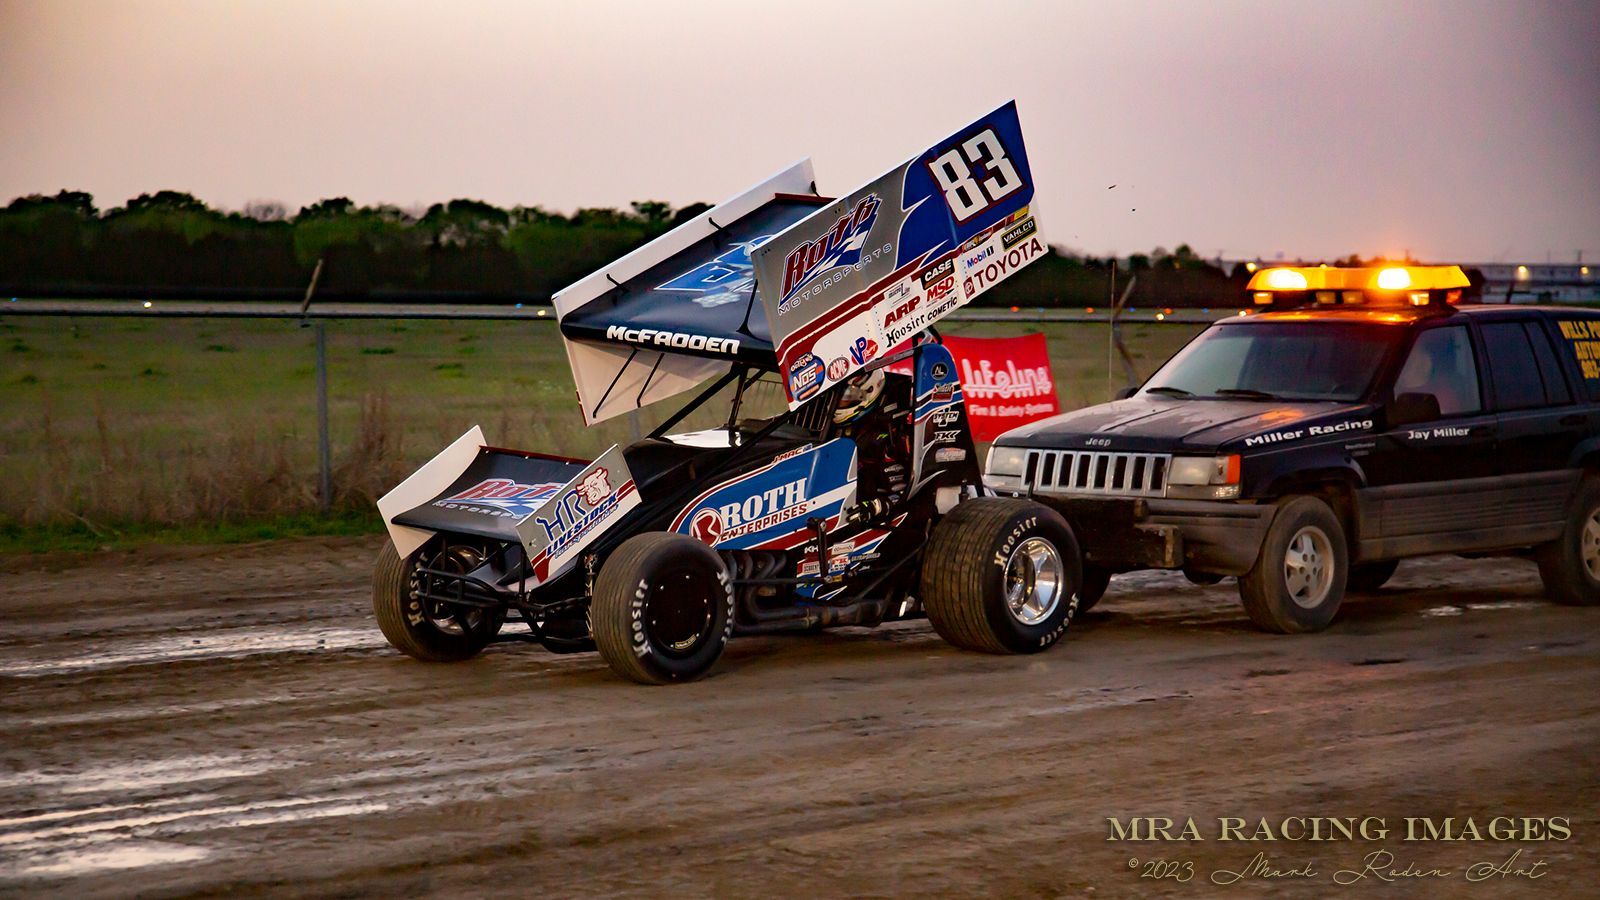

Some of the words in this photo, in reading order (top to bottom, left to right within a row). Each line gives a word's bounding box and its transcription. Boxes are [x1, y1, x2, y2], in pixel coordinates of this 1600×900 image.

[928, 129, 1023, 222] 83
[1003, 220, 1034, 243] VAHLCO
[778, 192, 883, 309] Roth
[966, 251, 987, 268] Mobil
[973, 237, 1043, 288] TOYOTA
[777, 242, 893, 316] MOTORSPORTS
[924, 260, 952, 282] CASE
[926, 276, 955, 302] MSD
[884, 295, 920, 328] ARP
[927, 296, 958, 321] COMETIC
[886, 314, 925, 348] Hoosier
[849, 336, 868, 365] VP
[793, 366, 817, 391] NOS
[829, 359, 847, 379] ACME
[1085, 437, 1111, 447] Jeep
[1245, 430, 1304, 446] Miller
[1309, 419, 1373, 436] Racing
[1408, 430, 1430, 440] Jay
[1433, 427, 1470, 438] Miller
[449, 479, 564, 500] Rot
[719, 477, 807, 529] ROTH
[547, 493, 617, 556] LIVESTOCK
[720, 504, 807, 542] ENTERPRISES
[994, 516, 1037, 571] Hoosier
[632, 579, 653, 658] Hoosier
